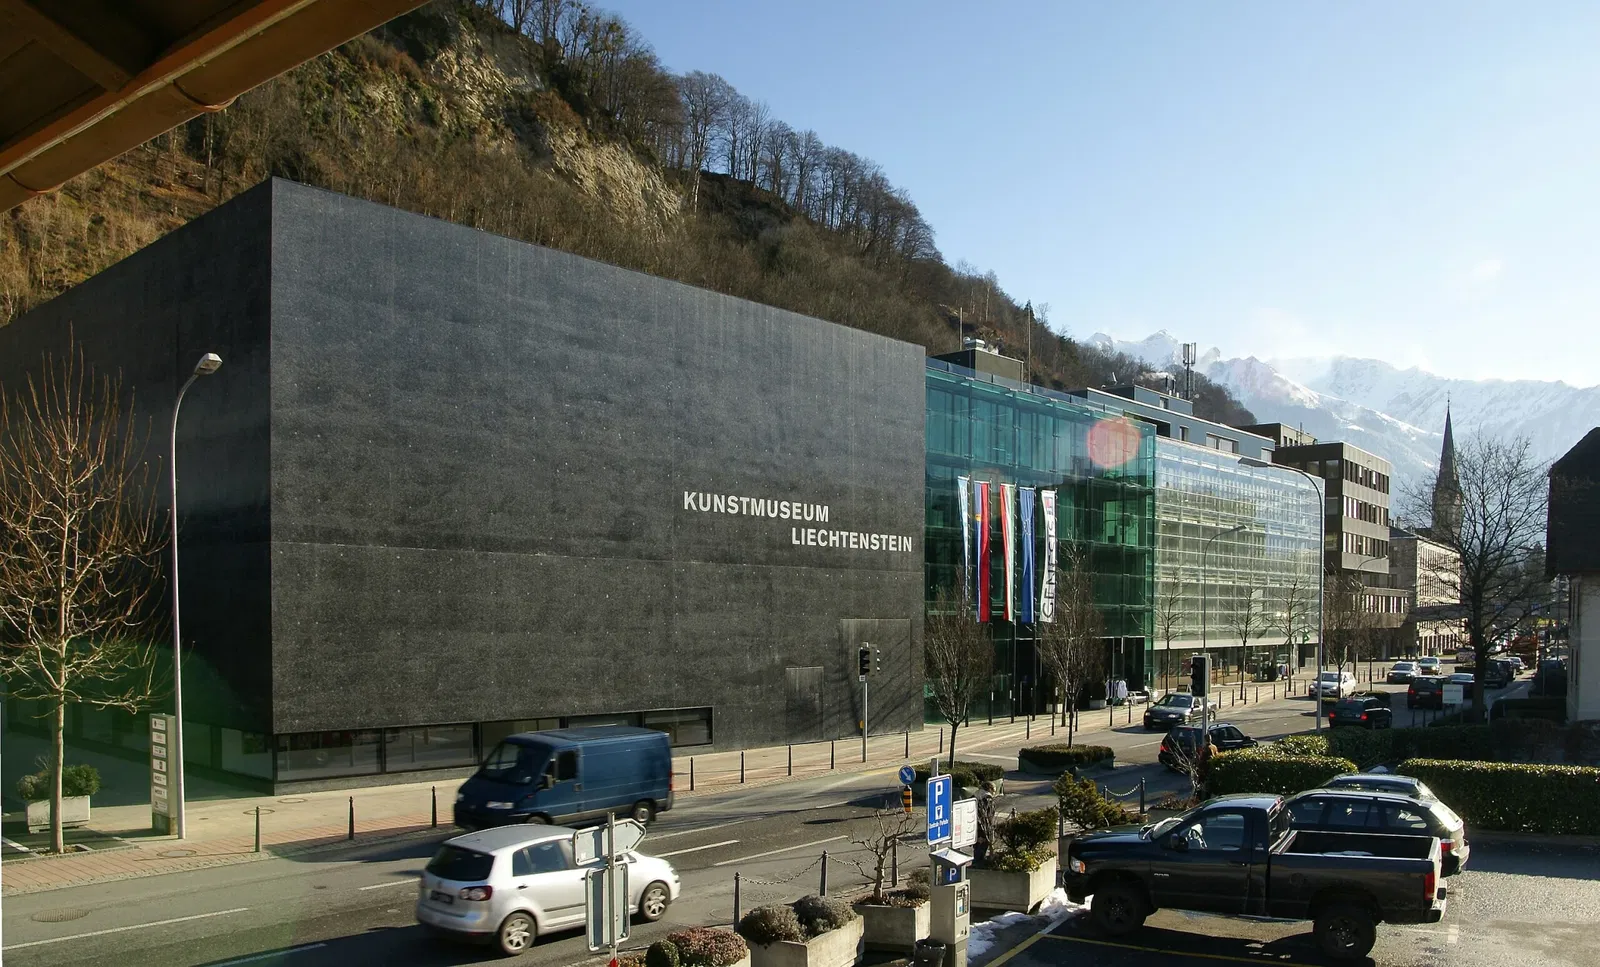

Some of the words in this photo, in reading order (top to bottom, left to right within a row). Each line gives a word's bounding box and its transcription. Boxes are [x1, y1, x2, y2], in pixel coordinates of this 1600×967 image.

[683, 491, 829, 522] KUNSTMUSEUM
[791, 527, 912, 552] LIECHTENSTEIN
[935, 781, 943, 804] P
[949, 867, 957, 881] P
